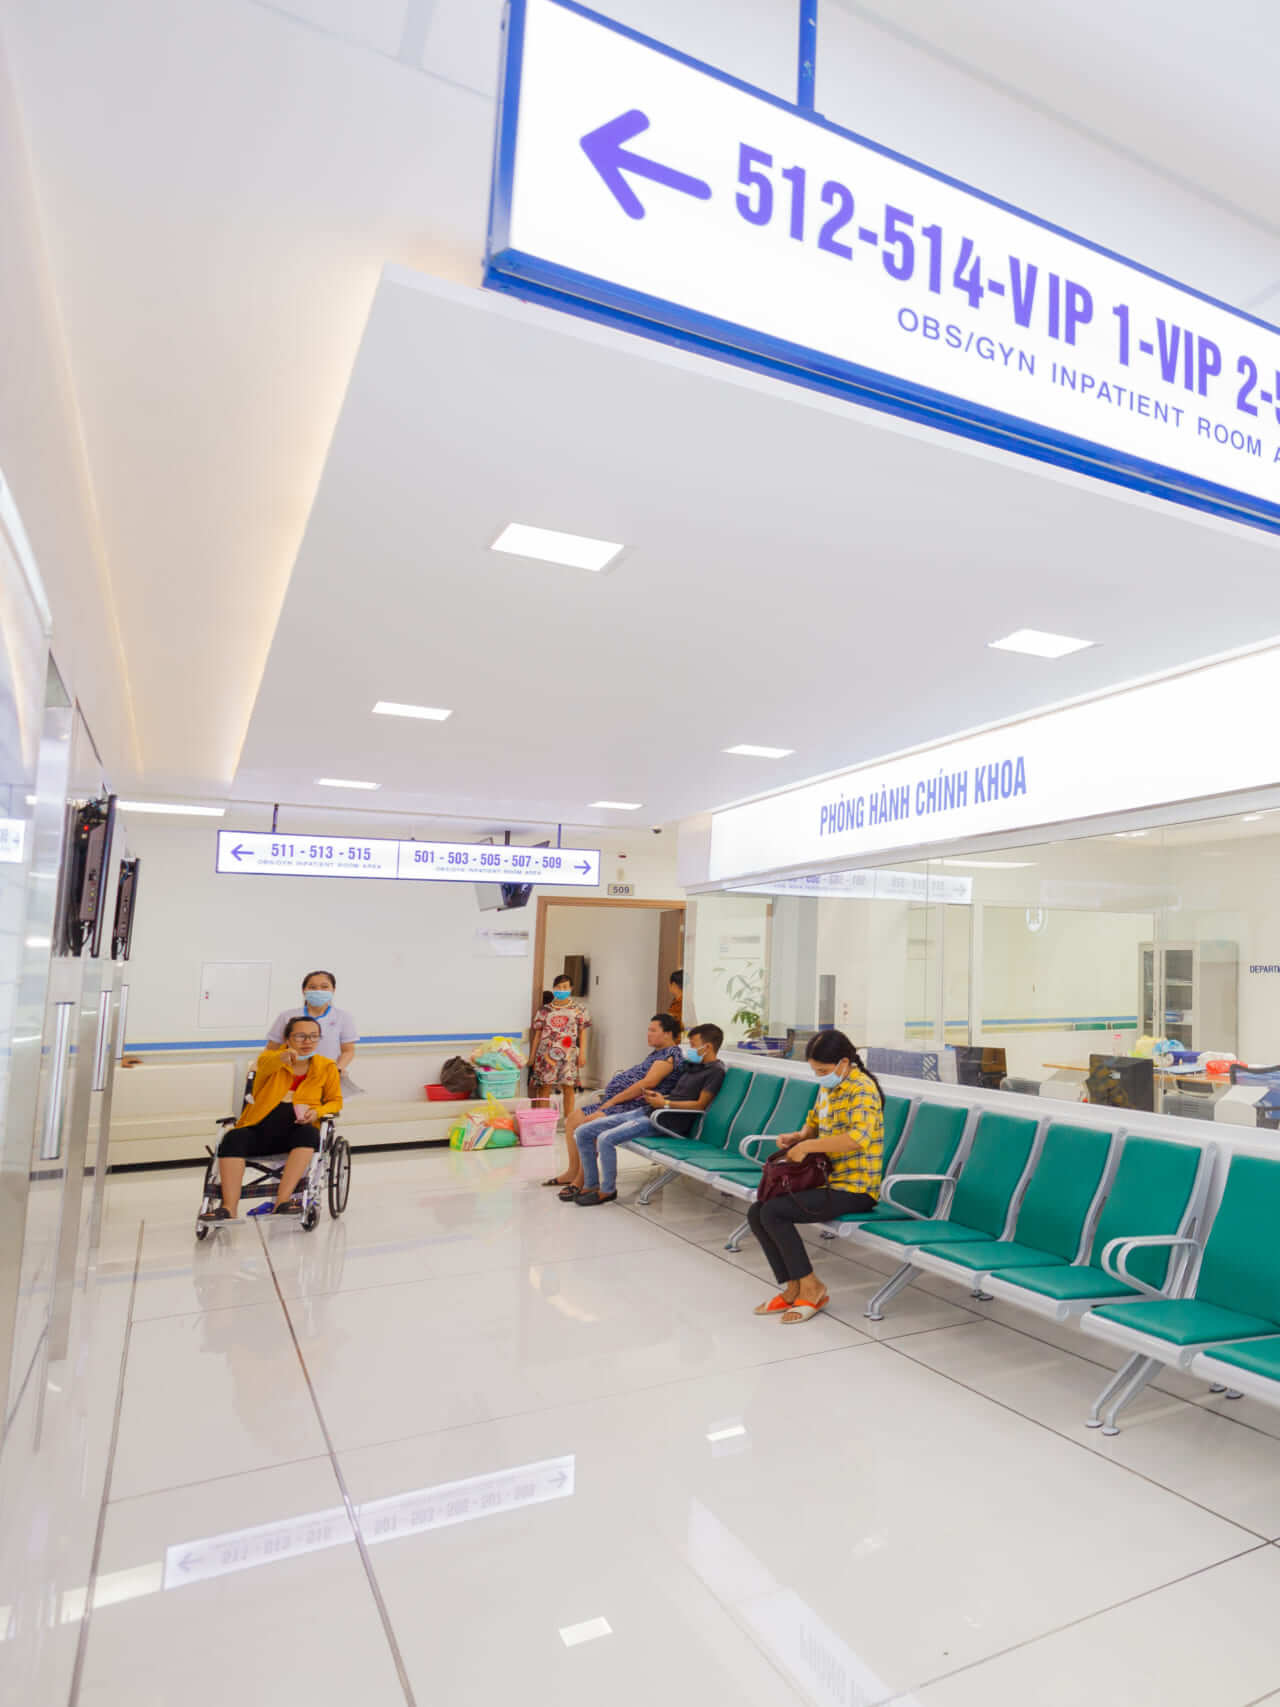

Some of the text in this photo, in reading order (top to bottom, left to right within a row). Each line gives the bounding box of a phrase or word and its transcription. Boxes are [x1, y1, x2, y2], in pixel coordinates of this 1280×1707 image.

[736, 142, 1094, 347] 512-514-VIP
[1112, 304, 1223, 398] 1-VIP
[897, 307, 1036, 375] OBS/GYN
[1051, 362, 1185, 428] INPATIENT
[1197, 416, 1263, 457] ROOM
[915, 767, 969, 817] CHÍNH
[974, 756, 1027, 806] KHOA
[271, 843, 295, 857] 511
[309, 845, 334, 859] 513
[348, 847, 372, 861] 515
[414, 850, 435, 864] 501
[447, 852, 469, 865] 503
[480, 853, 501, 867] 505
[511, 855, 532, 868] 507
[542, 856, 562, 869] 509
[612, 886, 630, 895] 509
